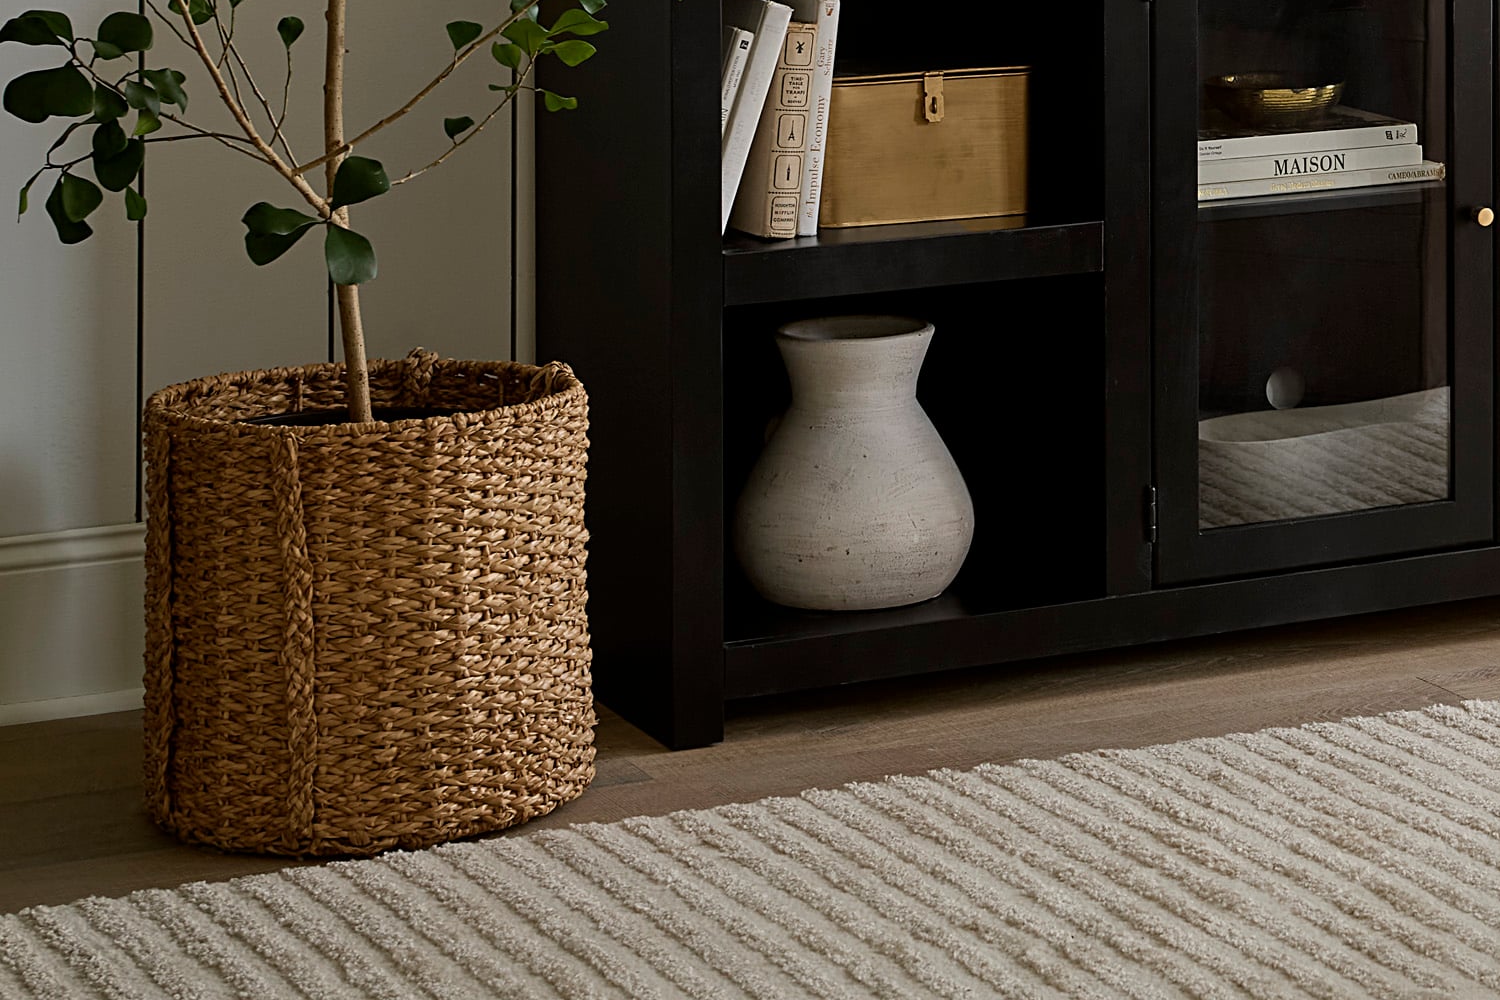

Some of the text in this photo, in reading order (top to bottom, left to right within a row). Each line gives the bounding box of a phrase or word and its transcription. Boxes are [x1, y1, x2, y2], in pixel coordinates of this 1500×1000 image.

[817, 46, 826, 67] Gary
[824, 39, 833, 76] Schwartz
[805, 95, 827, 218] the Impulse Economy
[1274, 153, 1346, 176] MAISON
